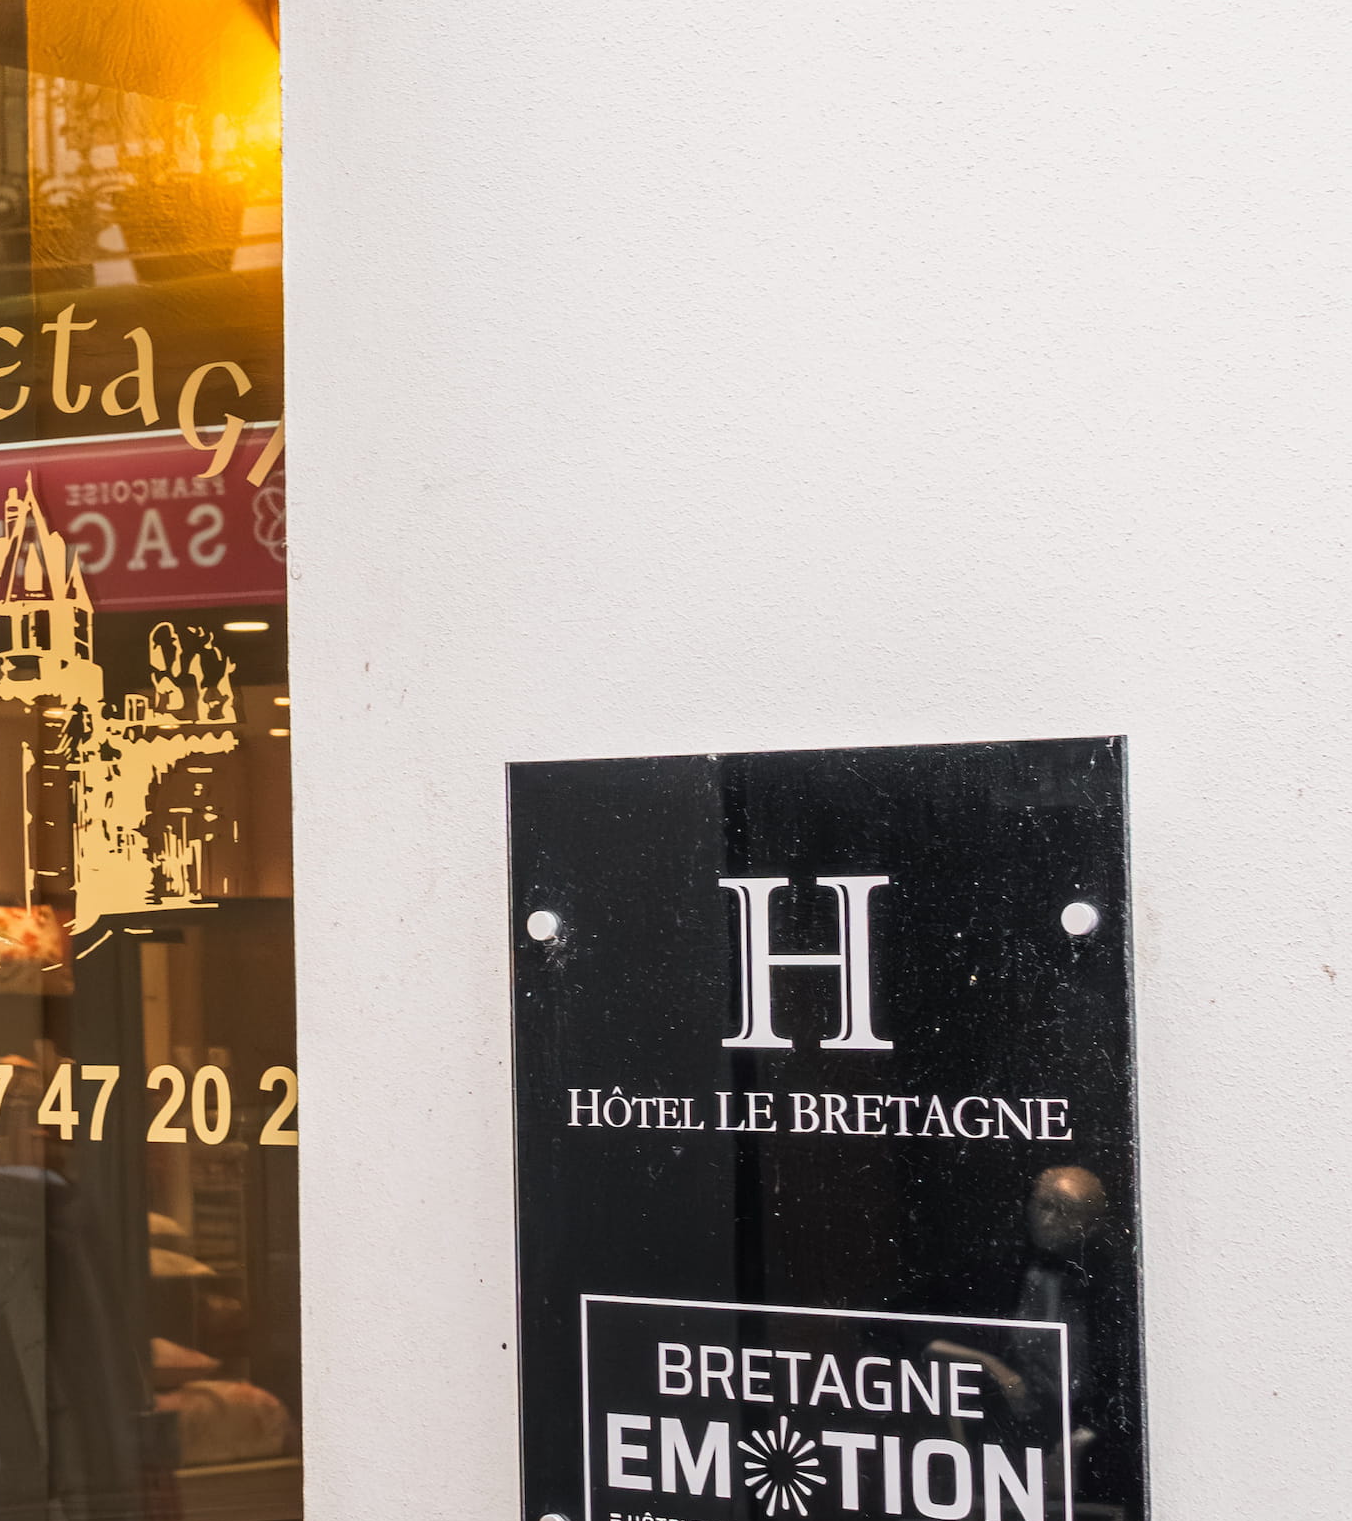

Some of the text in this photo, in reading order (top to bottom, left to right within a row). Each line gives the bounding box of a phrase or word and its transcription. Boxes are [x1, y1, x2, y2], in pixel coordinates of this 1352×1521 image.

[718, 874, 896, 1051] H
[37, 1063, 121, 1141] 47
[146, 1064, 232, 1146] 20
[714, 1089, 778, 1135] LE
[788, 1092, 1074, 1142] BRETAGNE
[656, 1341, 985, 1420] BRETAGNE
